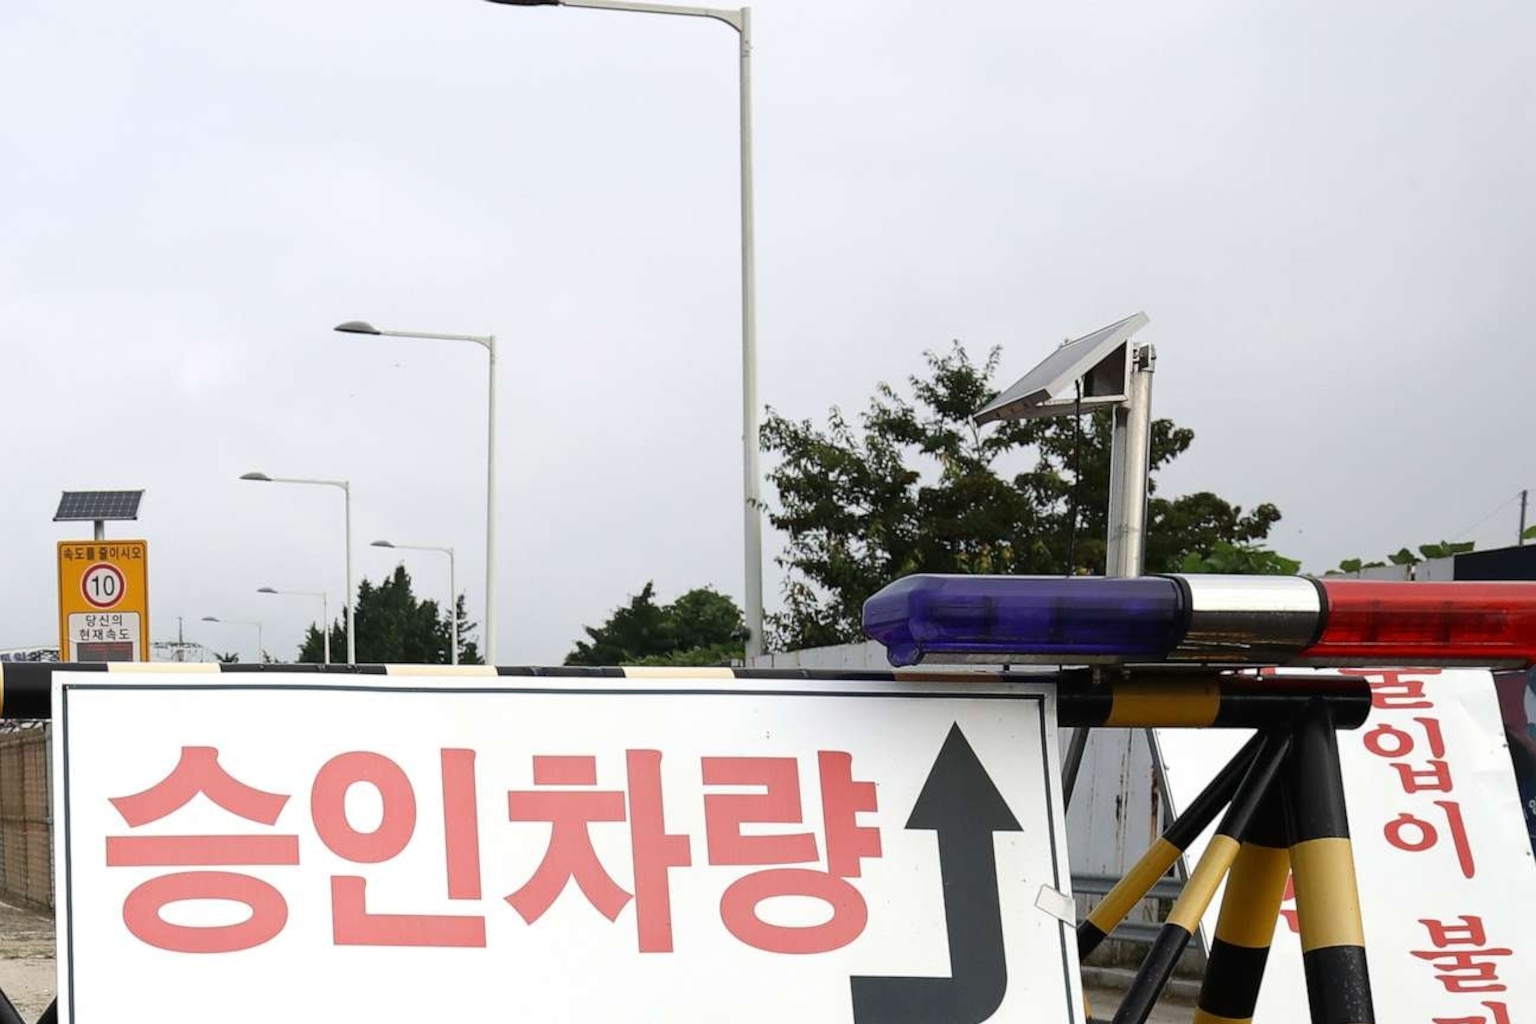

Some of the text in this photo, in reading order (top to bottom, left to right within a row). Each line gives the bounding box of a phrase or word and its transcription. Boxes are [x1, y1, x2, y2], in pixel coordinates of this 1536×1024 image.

[63, 546, 142, 561] 속도를 줄이시오
[91, 575, 115, 596] 10
[85, 614, 123, 627] 당신의
[79, 628, 131, 641] 현재속도
[107, 748, 881, 953] 승인차량
